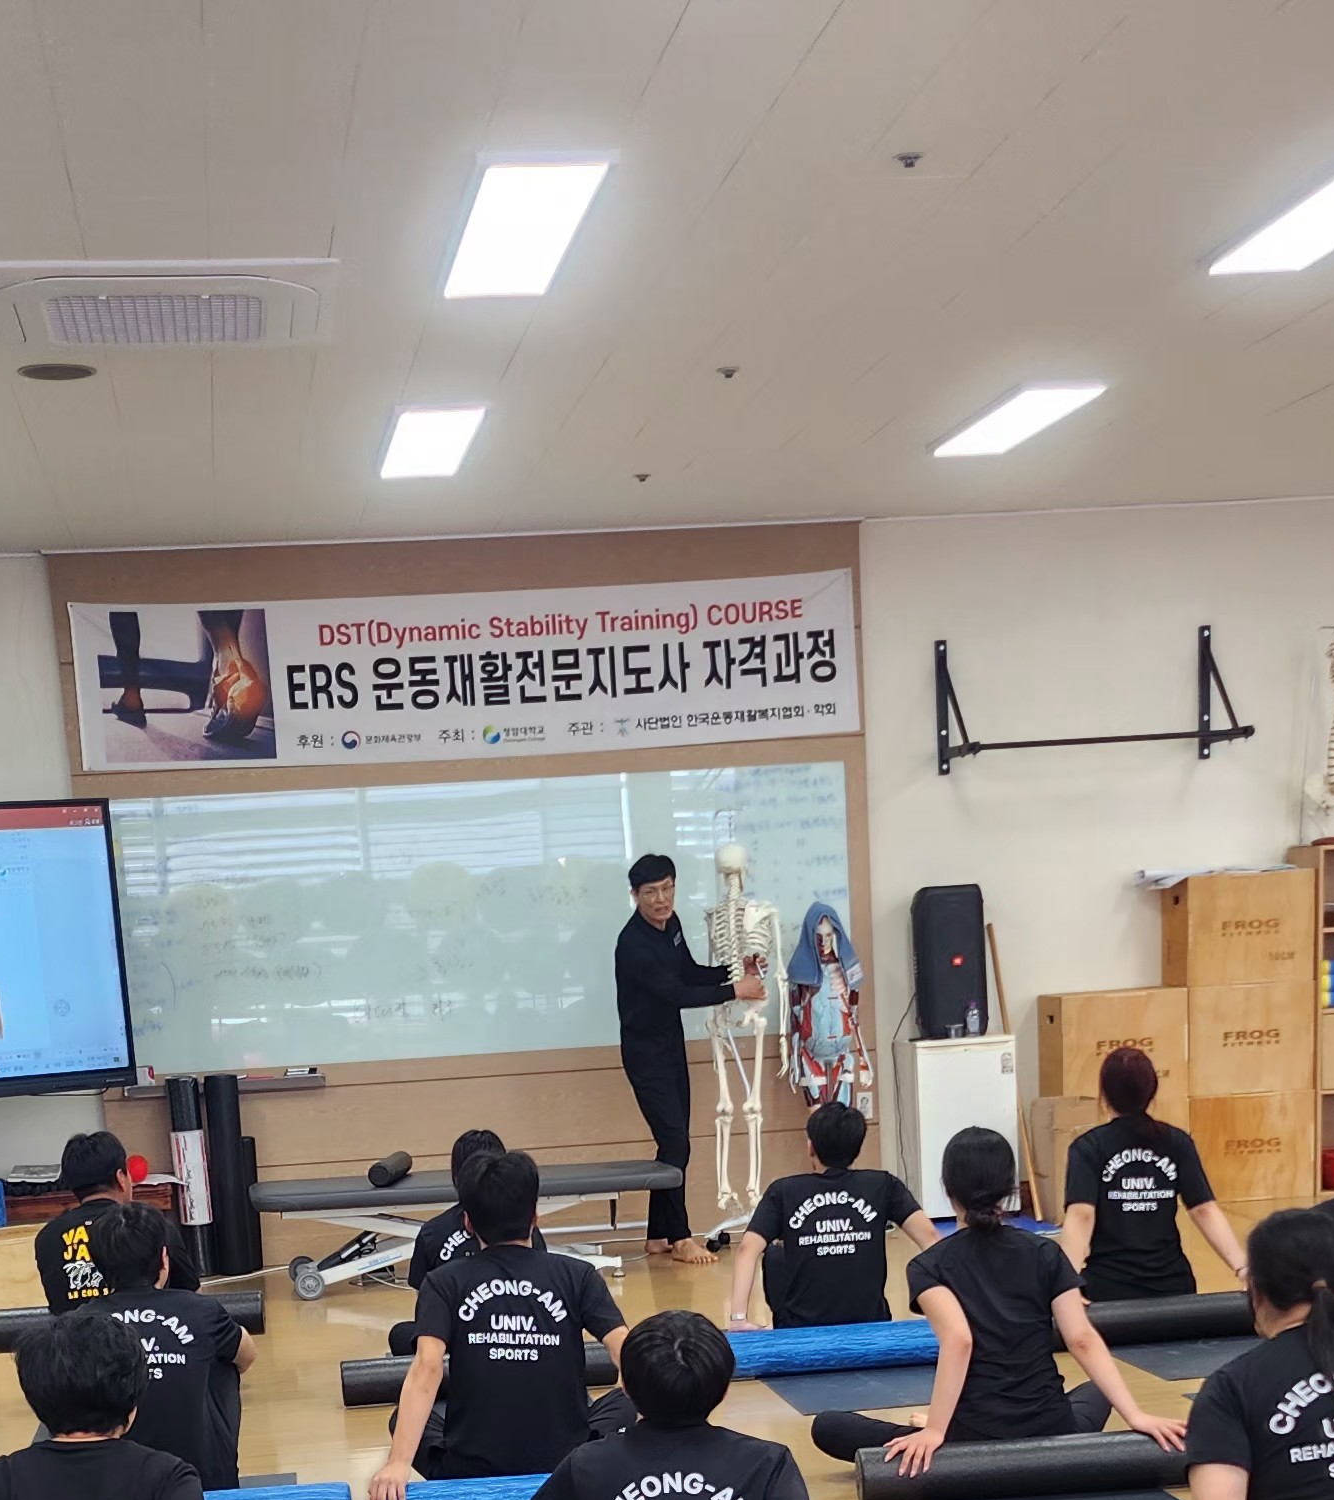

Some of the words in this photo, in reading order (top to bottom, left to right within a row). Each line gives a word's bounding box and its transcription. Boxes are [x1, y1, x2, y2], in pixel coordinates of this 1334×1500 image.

[318, 618, 481, 649] DST(Dynamic
[489, 613, 588, 640] Stability
[595, 603, 698, 634] Training)
[707, 598, 803, 626] COURSE
[286, 662, 359, 710] ERS
[372, 640, 691, 711] 운동재활전문지도사
[702, 628, 837, 690] 자격과정
[297, 734, 324, 749] 후원
[439, 728, 464, 742] 주최
[568, 721, 594, 736] 주관
[635, 714, 682, 731] 사단법인
[1221, 918, 1280, 931] FROG
[1223, 1028, 1280, 1041] FROG
[1224, 1137, 1281, 1150] FROG
[1102, 1148, 1178, 1182] CHEONG-AM
[1122, 1177, 1156, 1189] UNIV.
[789, 1191, 877, 1229] CHEONG-AM
[1122, 1201, 1158, 1211] SPORTS
[816, 1218, 853, 1232] UNIV.
[799, 1231, 871, 1246] REHABILITATION
[817, 1244, 855, 1256] SPORTS
[458, 1279, 568, 1323] CHEONG-AM
[490, 1314, 537, 1332] UNIV.
[468, 1333, 560, 1346] REHABILITATION
[489, 1348, 538, 1361] SPORTS
